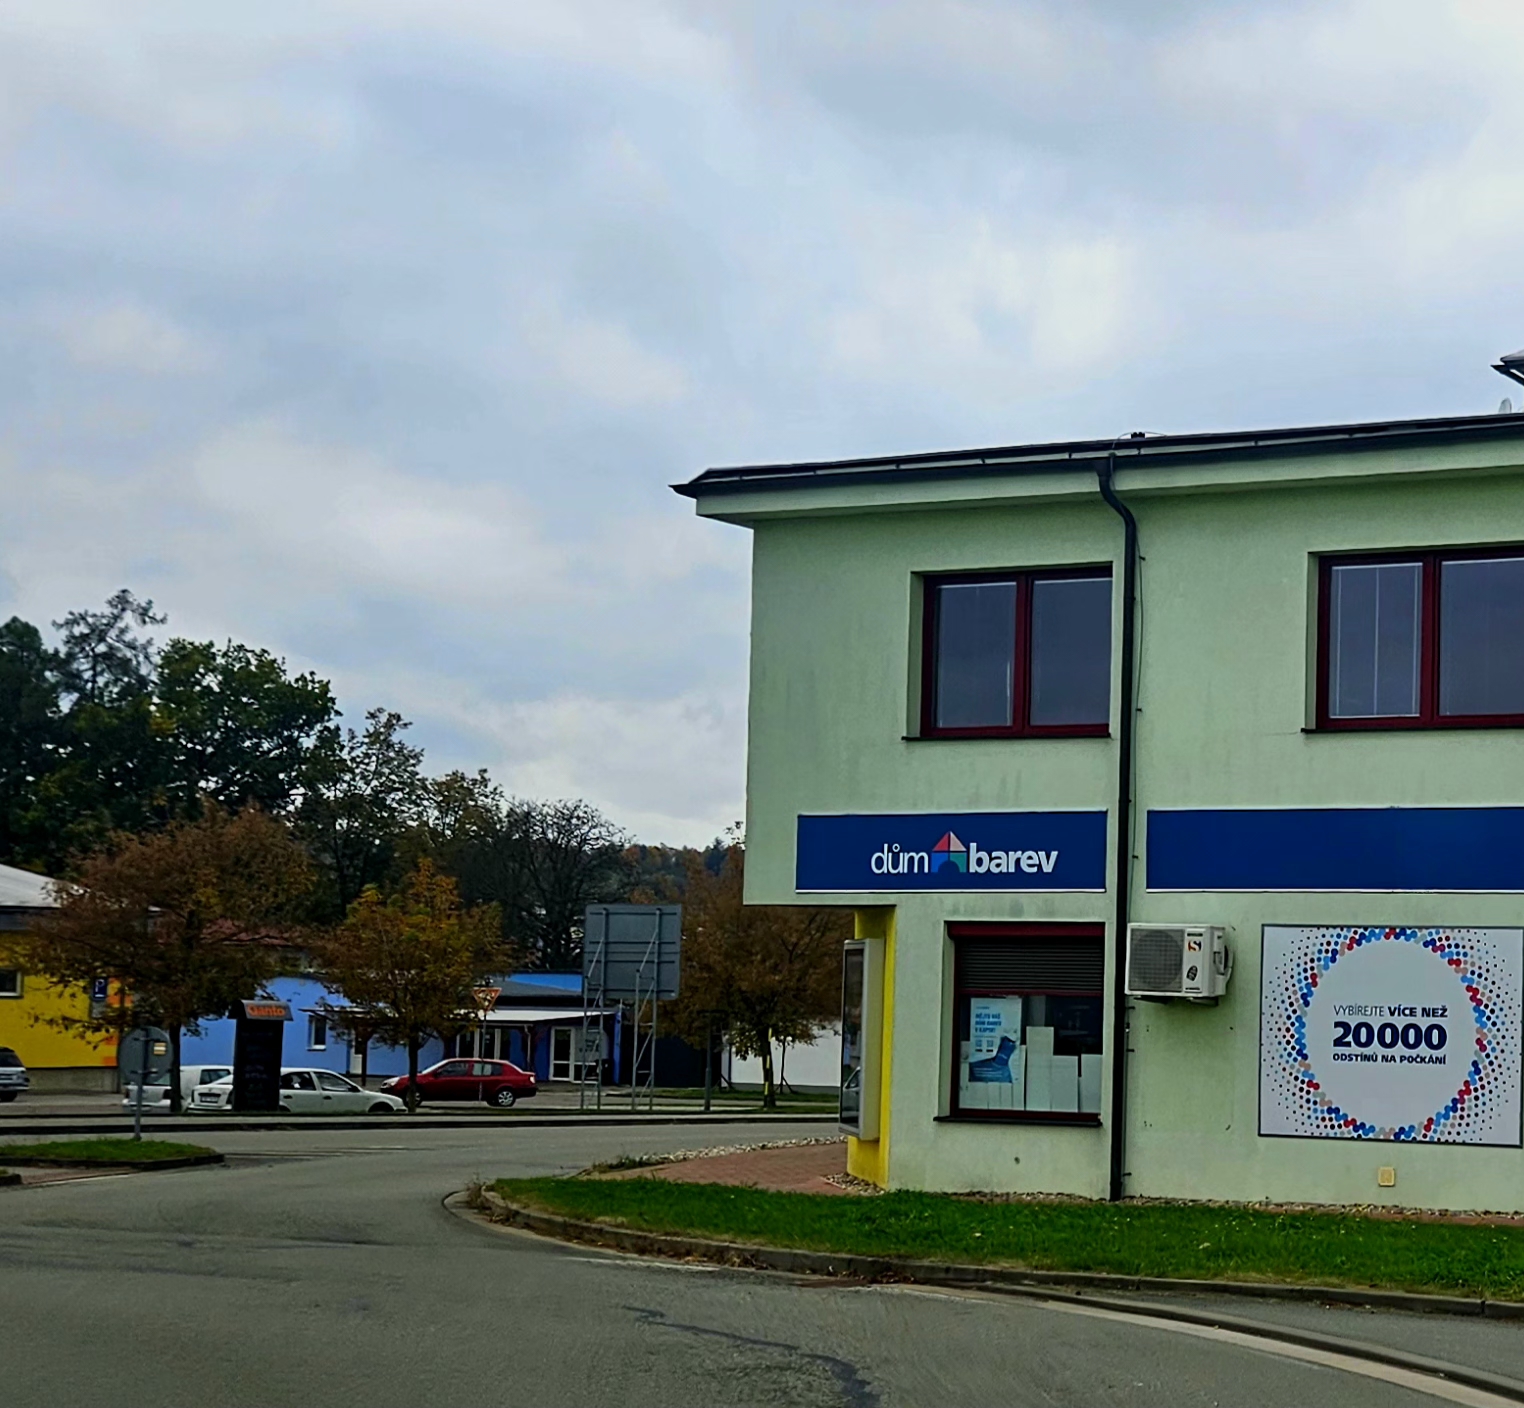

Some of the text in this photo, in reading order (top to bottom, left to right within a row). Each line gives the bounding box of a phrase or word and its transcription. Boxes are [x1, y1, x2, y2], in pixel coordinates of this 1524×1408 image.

[870, 842, 1059, 874] dům barev
[1333, 1003, 1449, 1018] VYBÍREJTE VÍCE NEŽ
[1332, 1051, 1447, 1065] ODSTÍNŮ NA POČKÁNÍ
